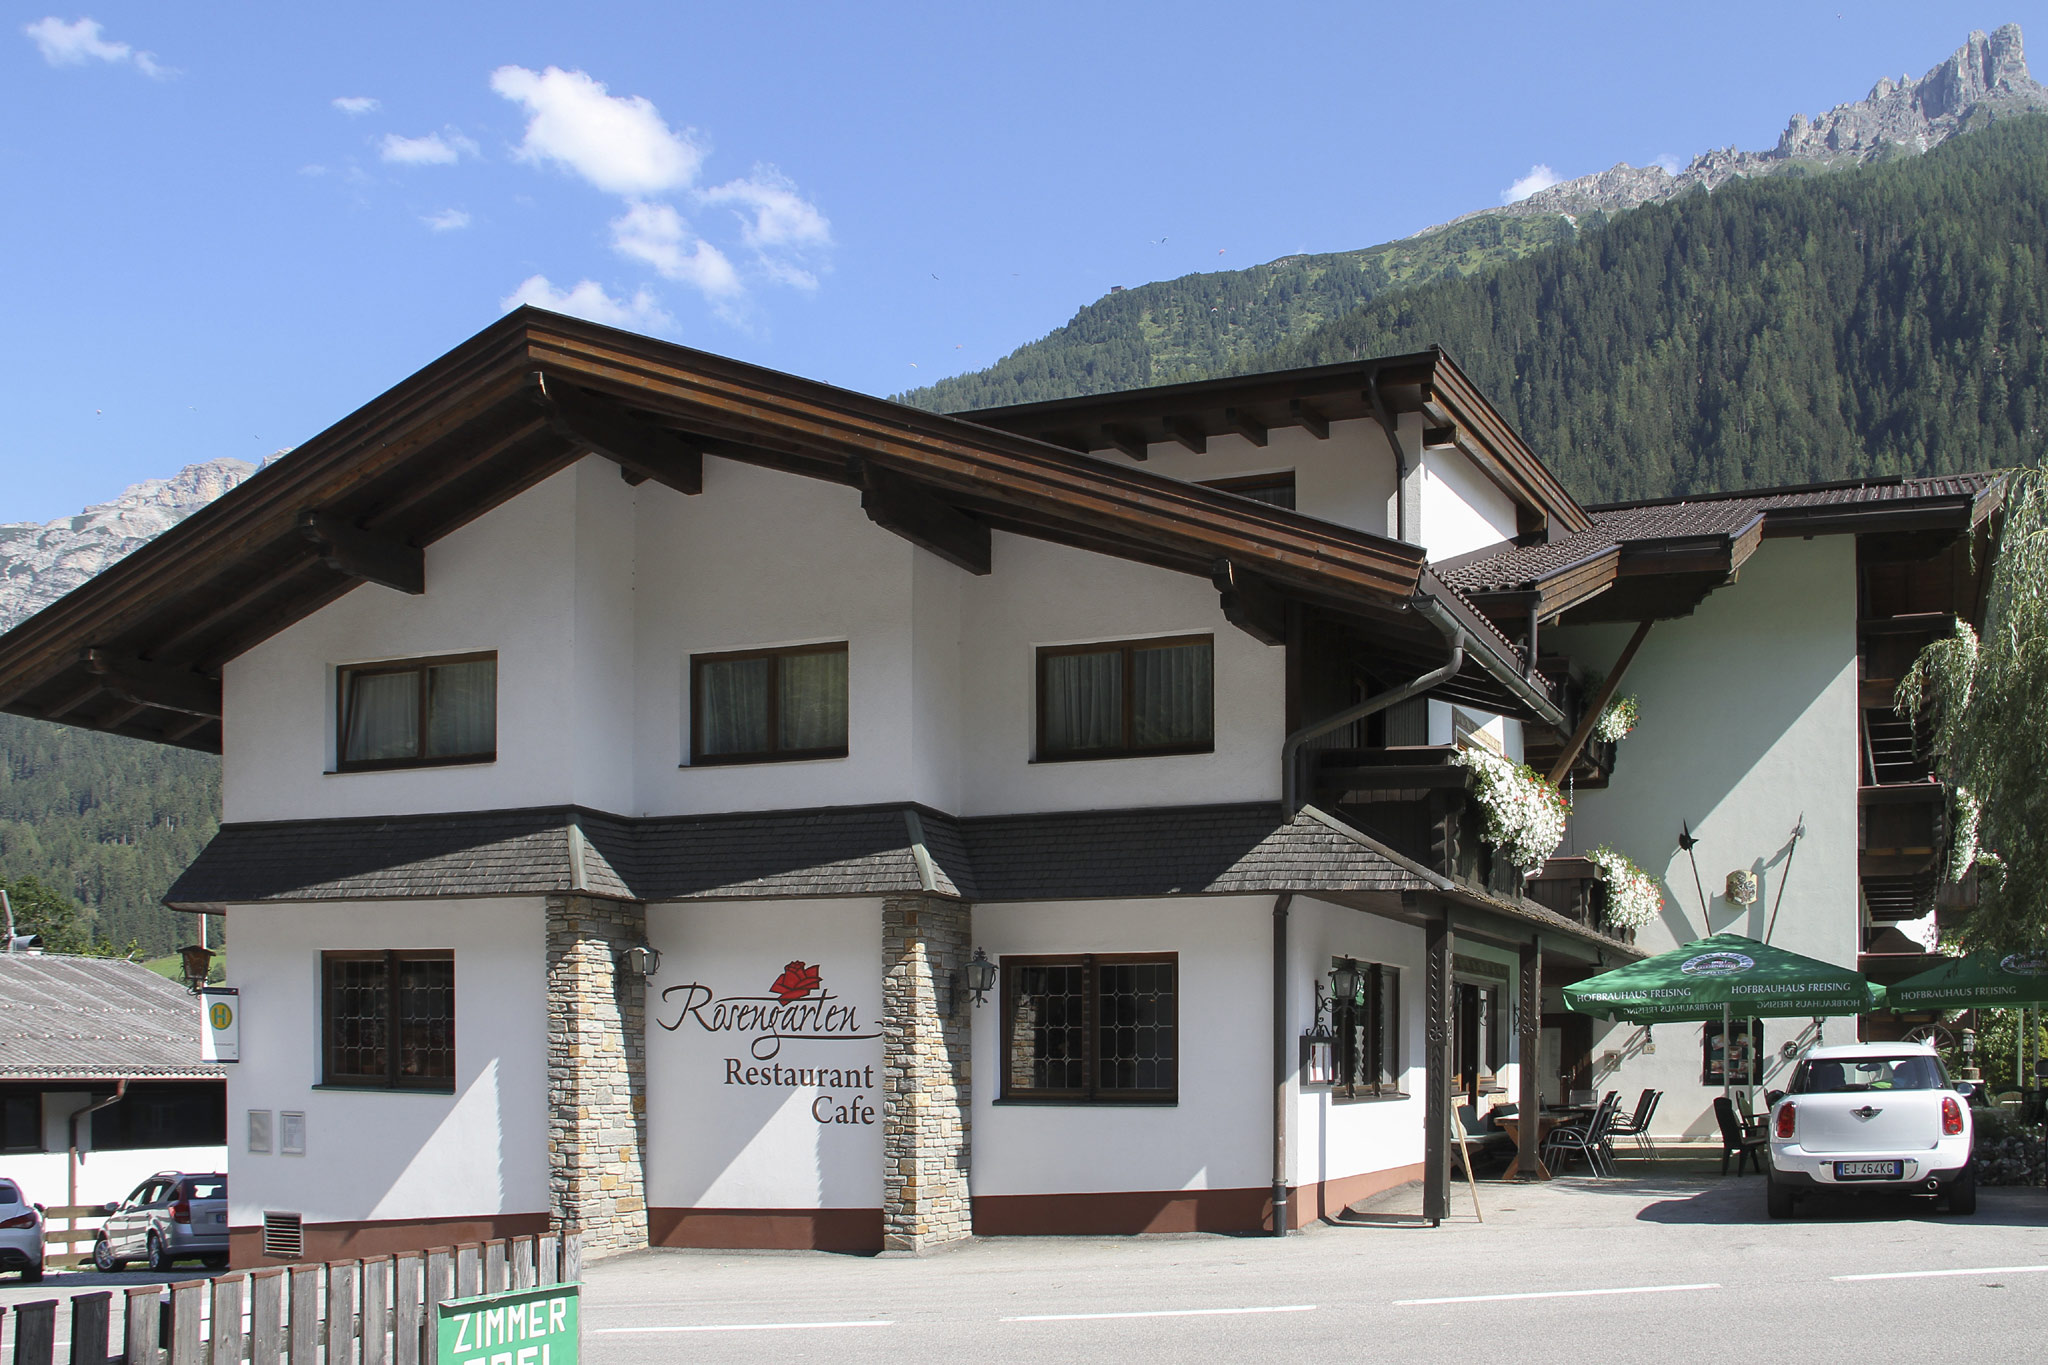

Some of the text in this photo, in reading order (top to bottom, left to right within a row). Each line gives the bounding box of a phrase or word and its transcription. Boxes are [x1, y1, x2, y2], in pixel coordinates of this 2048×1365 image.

[1576, 988, 1691, 1002] HOFBRAUHAUS FREISING
[1731, 982, 1850, 994] HOFBRAUHAUS FREISING
[1901, 988, 1972, 1000] HOFBRAUHAUS
[214, 1007, 226, 1025] H
[656, 982, 884, 1060] Rosengarten
[723, 1058, 874, 1088] Restaurant
[811, 1095, 875, 1125] Cafe
[452, 1297, 567, 1354] ZIMMER
